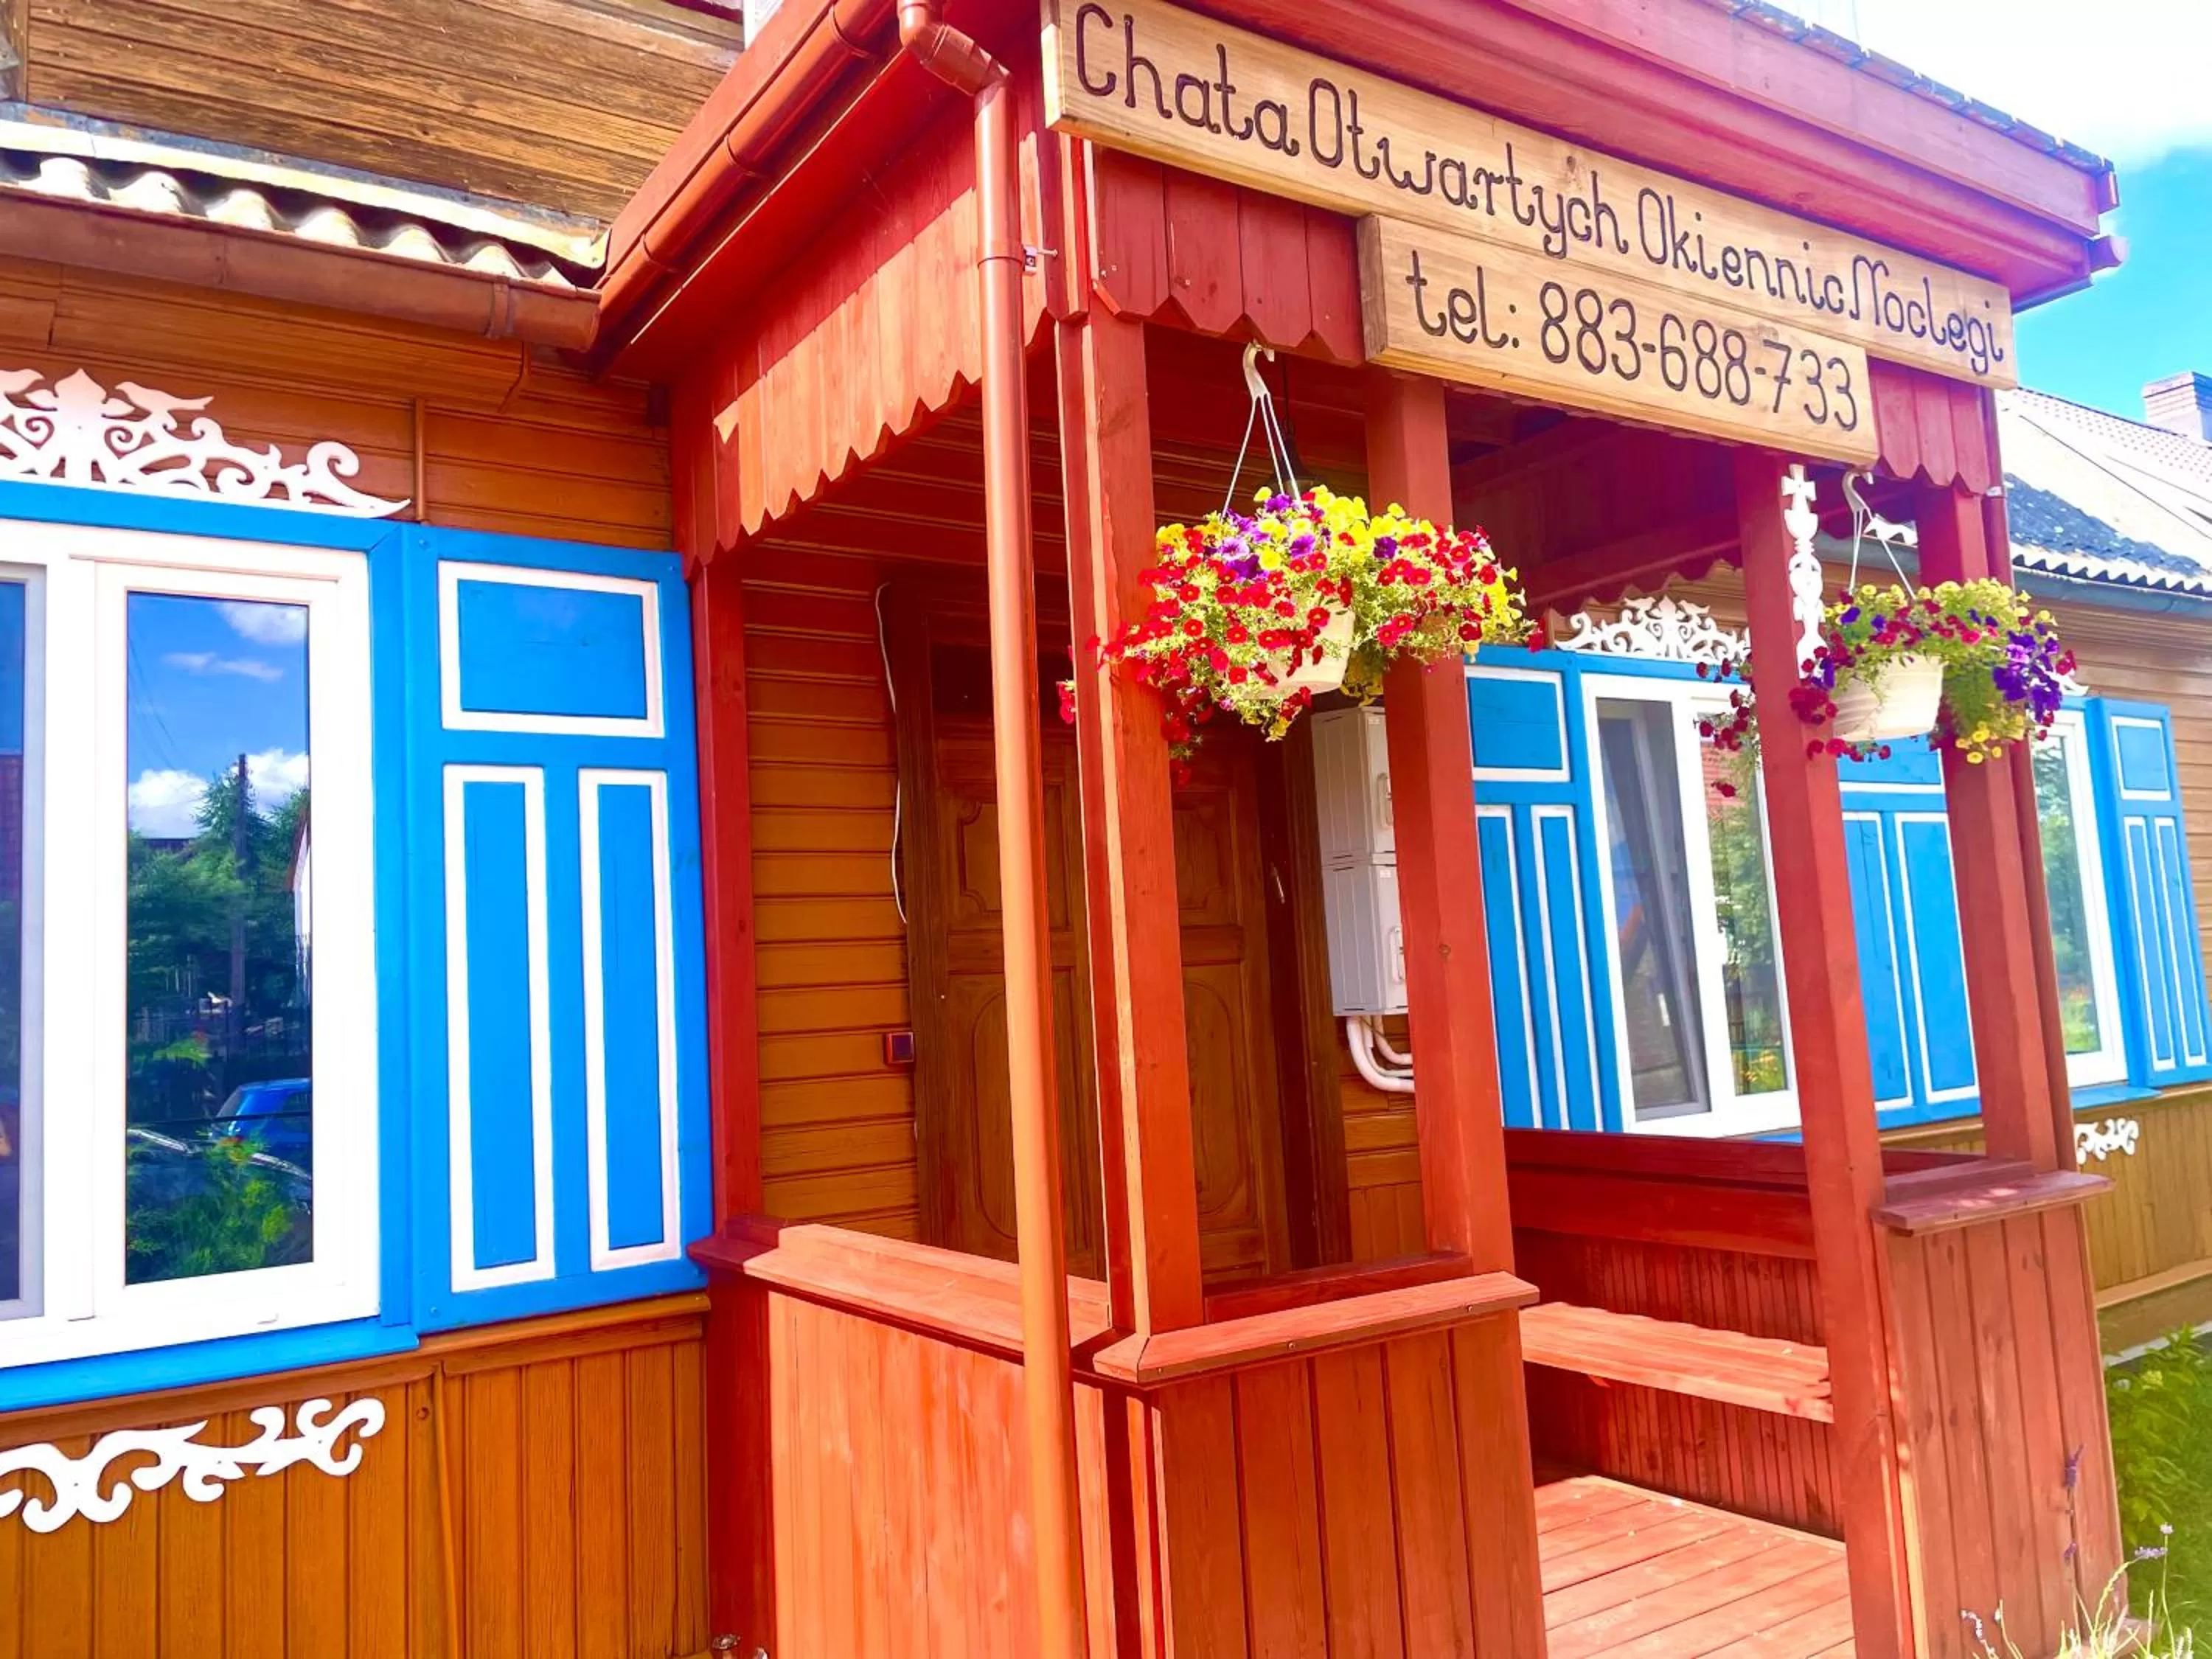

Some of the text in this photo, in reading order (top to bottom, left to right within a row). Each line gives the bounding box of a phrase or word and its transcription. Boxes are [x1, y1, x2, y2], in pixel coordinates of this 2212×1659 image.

[1075, 3, 2004, 375] Chata Otwartych Okiennic Noclegi
[1405, 249, 1858, 431] tel: 883-688-733
